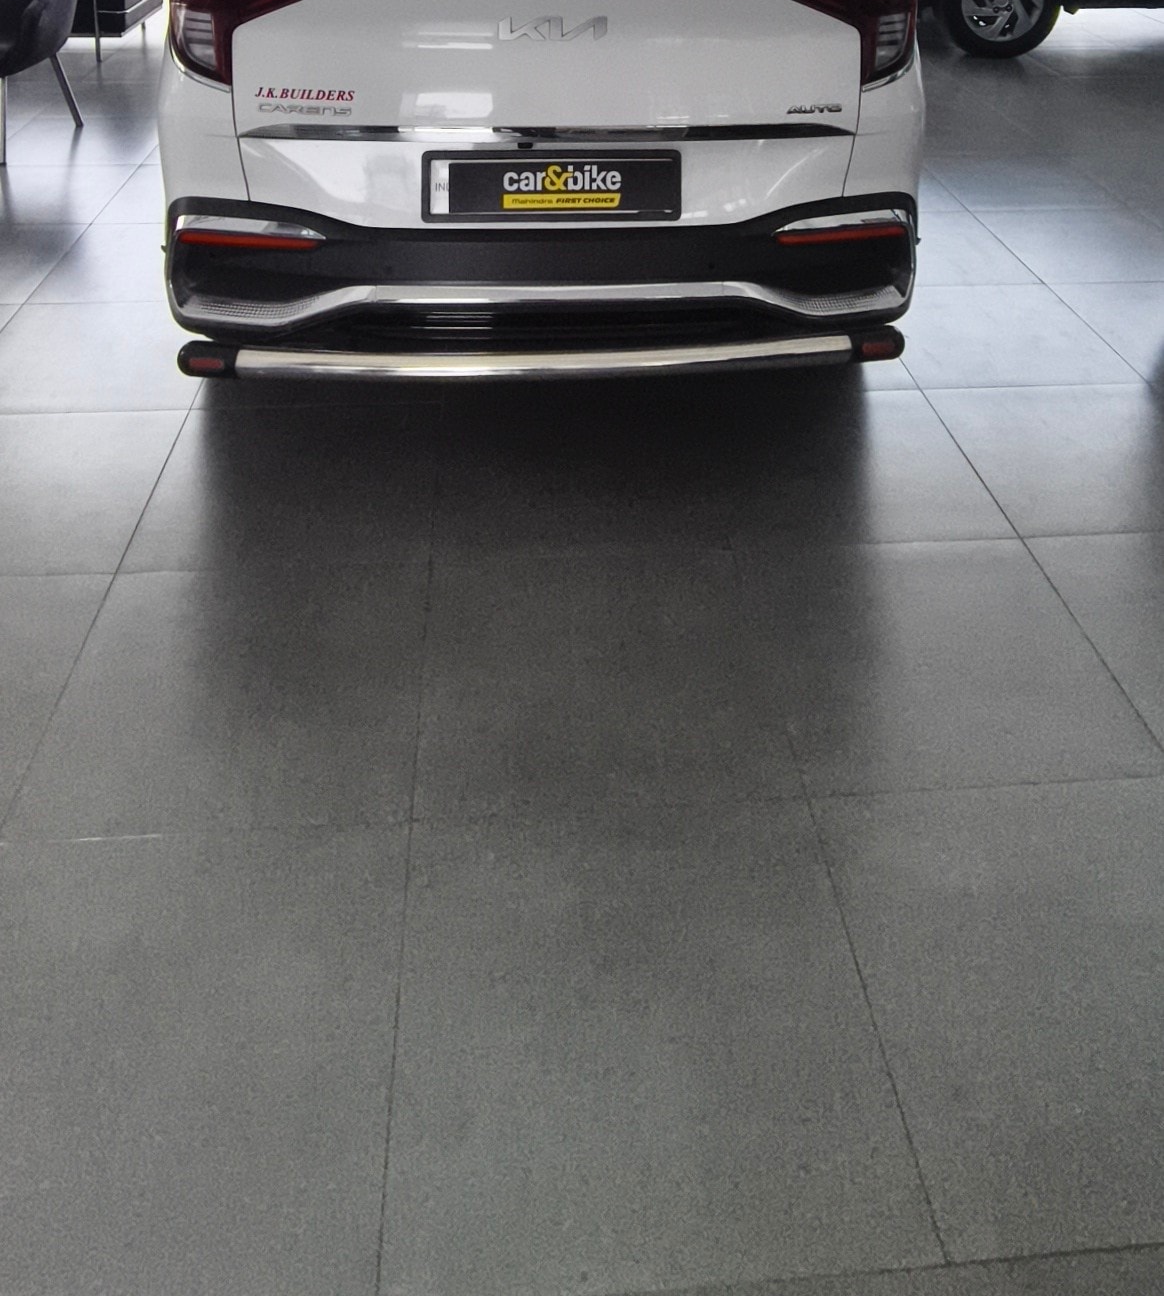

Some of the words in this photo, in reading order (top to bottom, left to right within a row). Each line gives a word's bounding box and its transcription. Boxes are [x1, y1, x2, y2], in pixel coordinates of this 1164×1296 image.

[497, 16, 608, 41] KIA
[786, 103, 843, 115] AUTO
[503, 165, 622, 192] car&bike
[556, 197, 582, 205] FIRST
[583, 197, 616, 205] CHOICE
